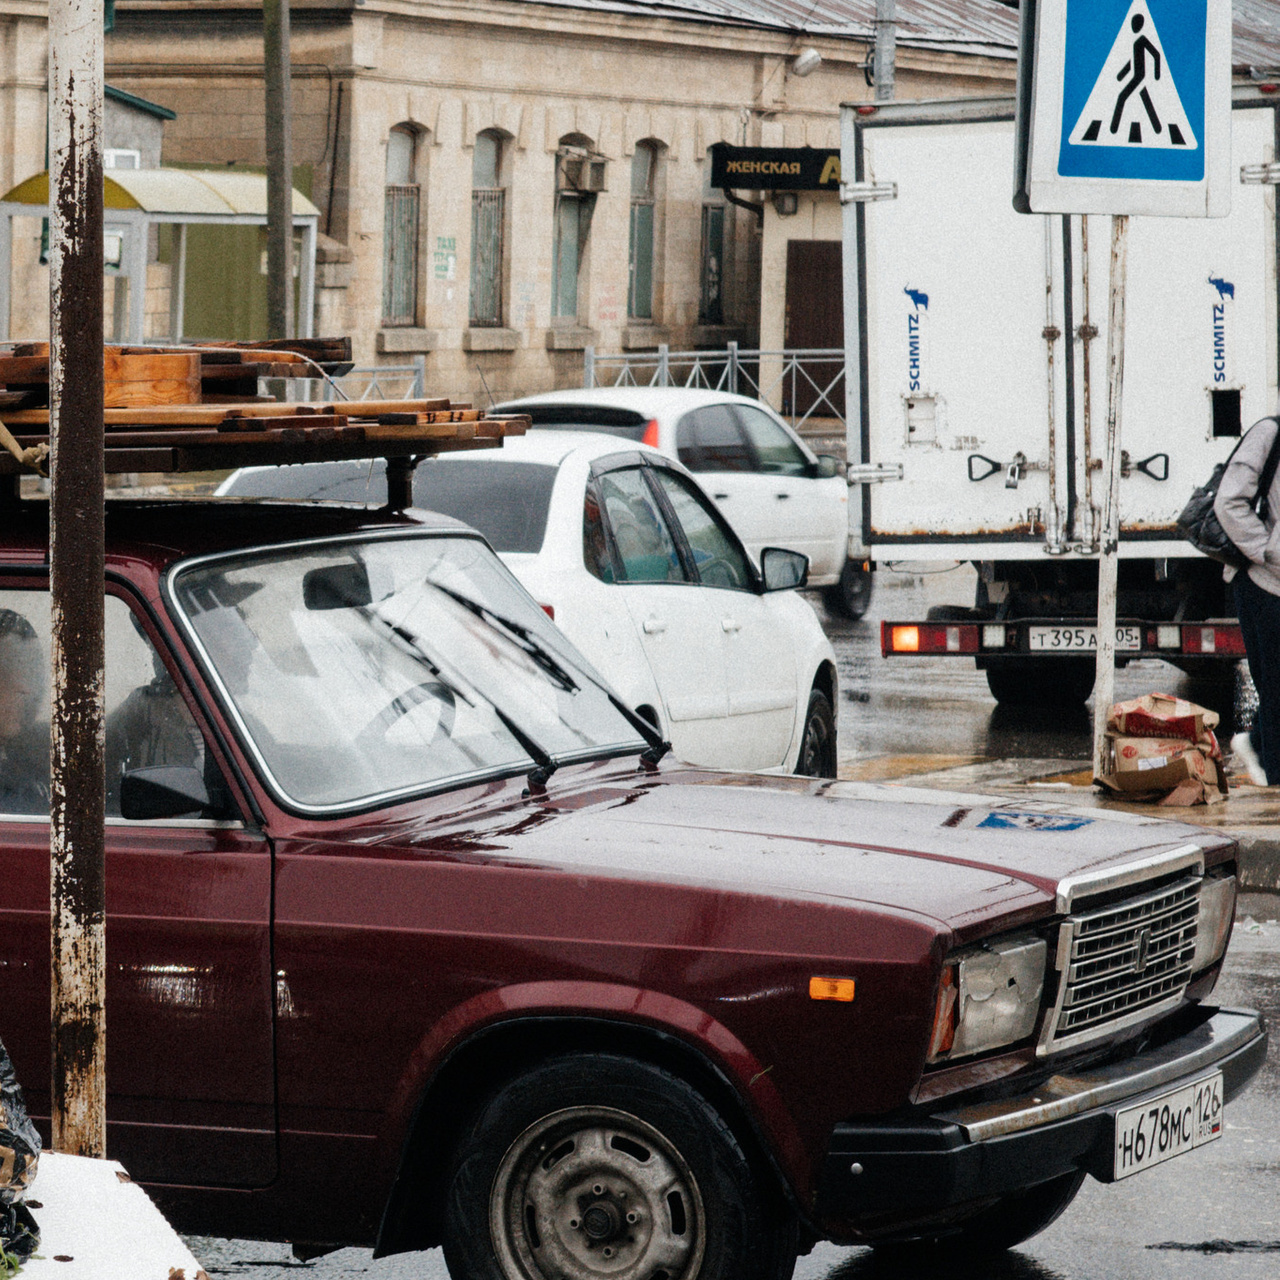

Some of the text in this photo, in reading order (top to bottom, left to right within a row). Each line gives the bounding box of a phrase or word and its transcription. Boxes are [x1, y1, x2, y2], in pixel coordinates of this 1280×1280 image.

[726, 161, 801, 175] ЖЕНСКАЯ
[908, 313, 920, 392] SCHMITZ
[1213, 304, 1225, 382] SCHMITZ
[1195, 1081, 1220, 1123] 126
